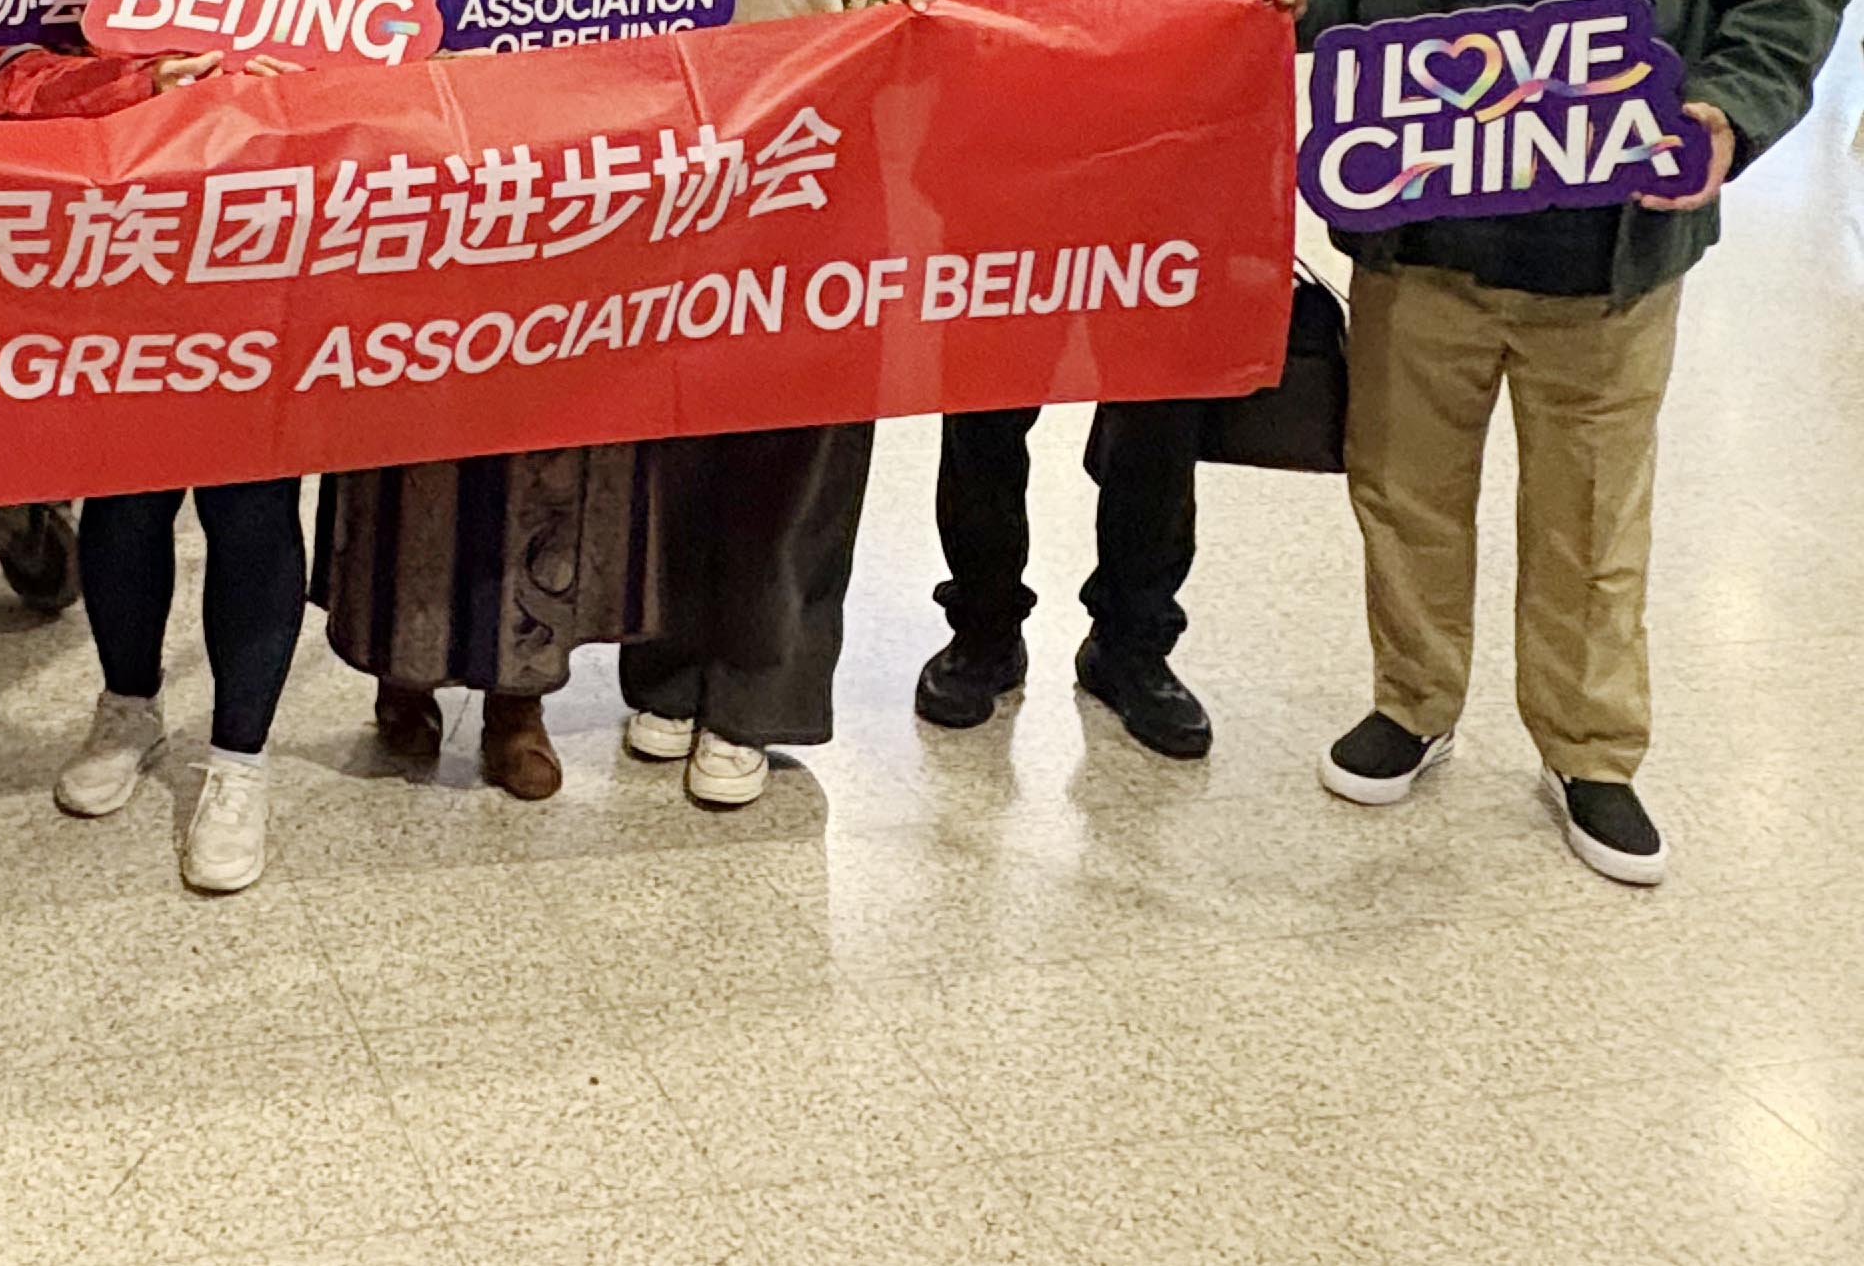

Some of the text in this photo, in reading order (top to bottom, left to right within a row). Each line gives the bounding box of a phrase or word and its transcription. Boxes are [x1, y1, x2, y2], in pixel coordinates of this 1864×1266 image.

[1335, 48, 1358, 124] I
[1319, 98, 1682, 210] CHINA
[294, 264, 787, 393] ASSOCIATION
[805, 256, 908, 331] OF
[920, 239, 1201, 322] BEIJING
